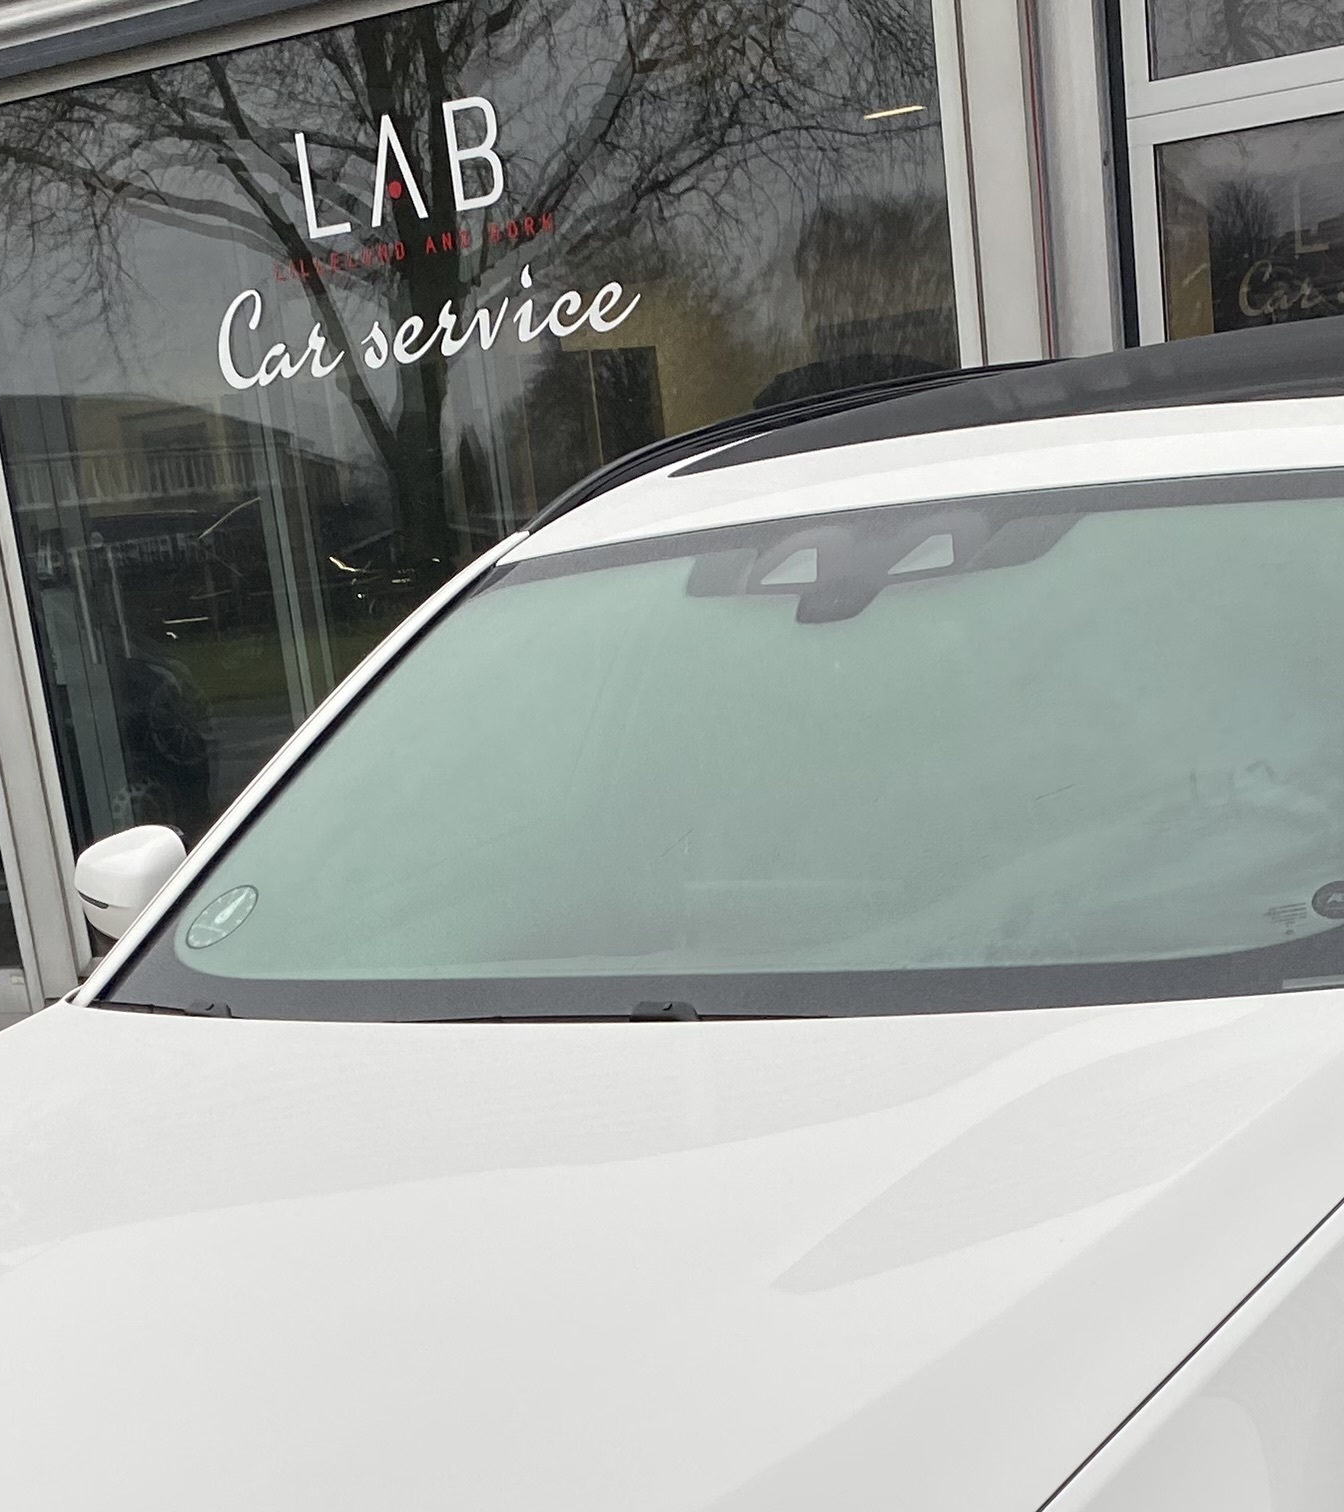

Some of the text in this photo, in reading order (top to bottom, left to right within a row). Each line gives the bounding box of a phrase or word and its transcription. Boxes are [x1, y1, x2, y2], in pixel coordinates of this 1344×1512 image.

[293, 95, 505, 240] LAB
[425, 228, 472, 255] AND
[217, 263, 642, 390] Car service
